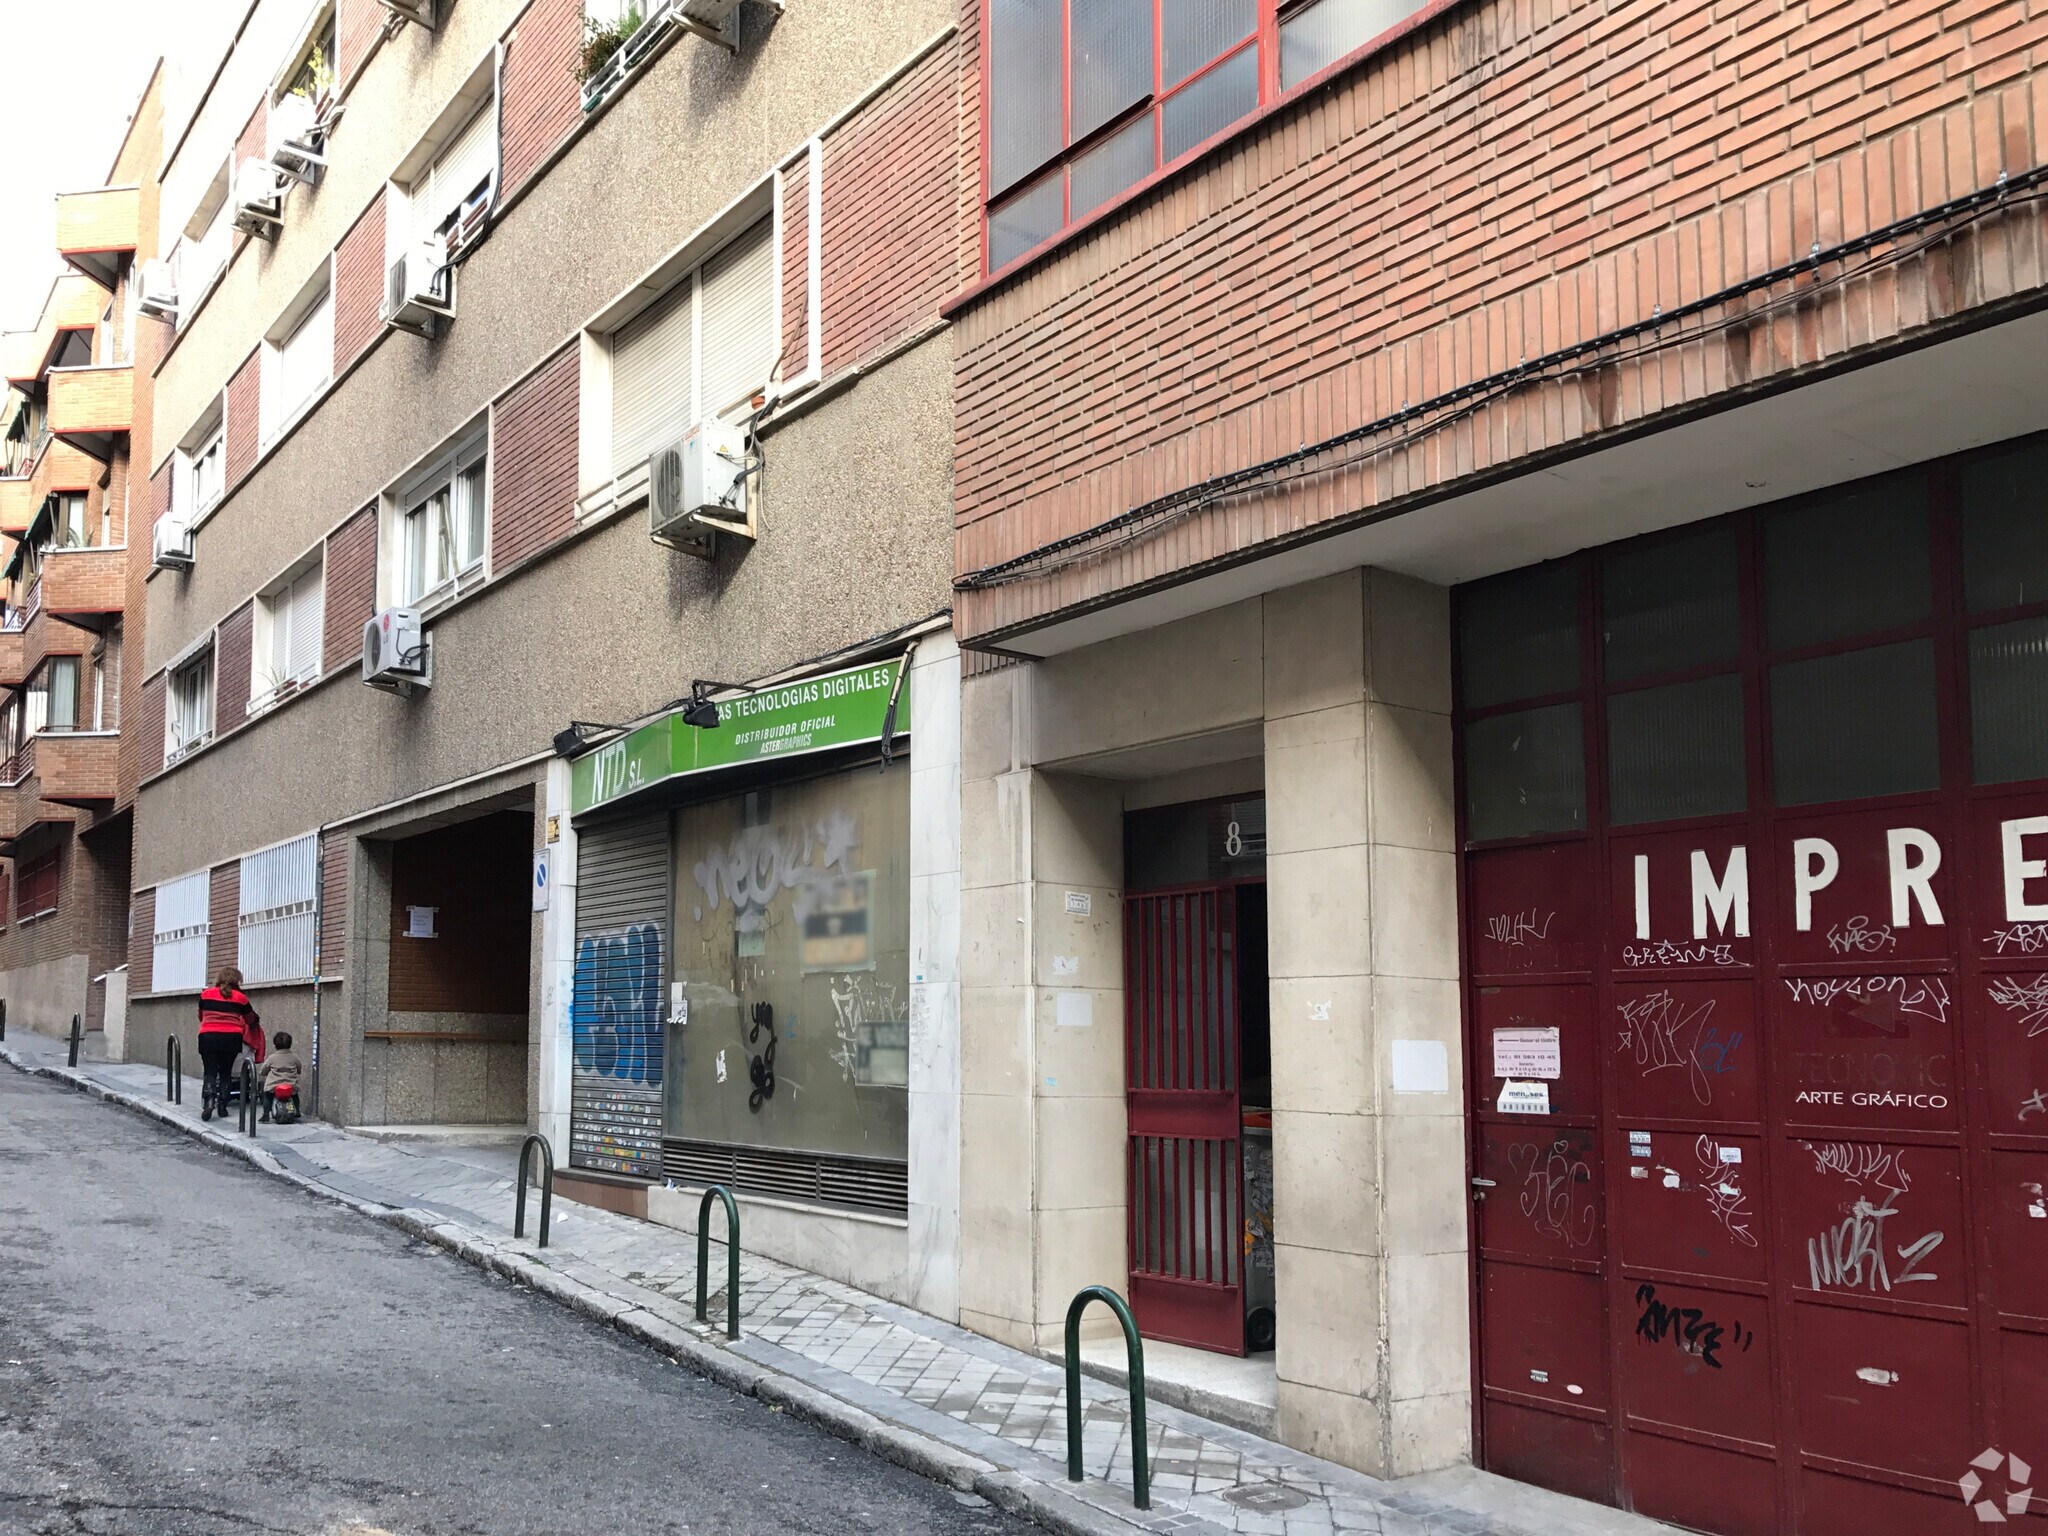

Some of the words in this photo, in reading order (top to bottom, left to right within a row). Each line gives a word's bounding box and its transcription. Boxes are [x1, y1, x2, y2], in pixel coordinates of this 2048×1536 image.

[735, 686, 819, 717] TECNOLOGIAS
[822, 668, 890, 699] DIGITALES
[735, 722, 797, 745] DISTRIBUIDOR
[800, 715, 836, 731] OFICIAL
[760, 733, 812, 754] ASTERGRAPHICS
[591, 740, 627, 805] NTD
[1226, 821, 1242, 857] 8
[1796, 1091, 1844, 1105] ARTE
[1851, 1090, 1948, 1108] GRÁFICO
